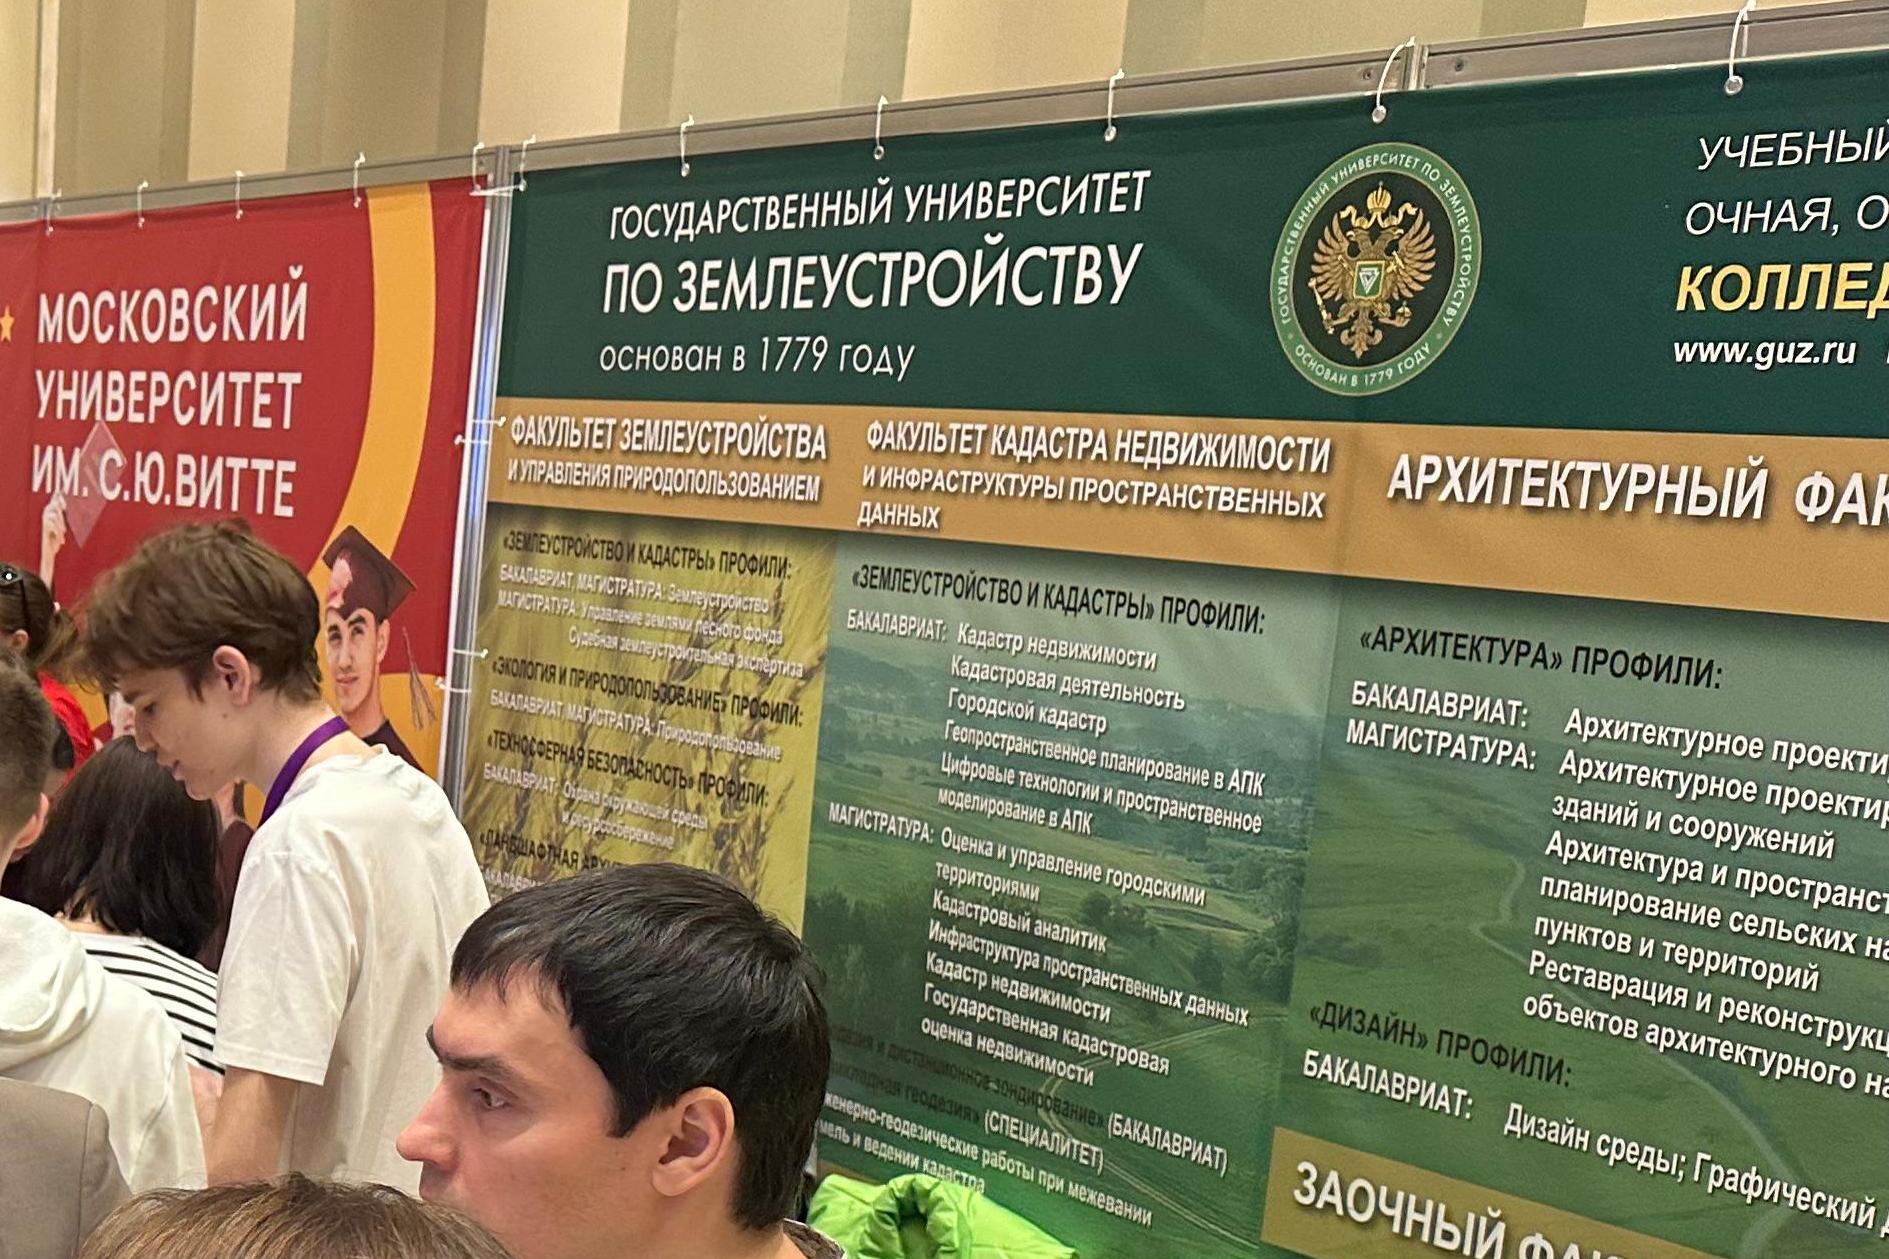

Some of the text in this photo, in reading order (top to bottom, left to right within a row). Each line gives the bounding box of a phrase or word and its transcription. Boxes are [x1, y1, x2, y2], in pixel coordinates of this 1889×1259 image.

[609, 169, 1151, 243] ГОСУДАРСТВЕННЫЙ УНИВЕРСИТЕТ
[1685, 198, 1839, 240] ОЧНАЯ,
[602, 232, 1144, 314] ПО ЗЕМЛЕУСТРОЙСТВУ
[1276, 152, 1473, 328] ГОСУДАРСТВЕННЫЙ УНИВЕРСИТЕТ ЗЕМЛЕУСТРОЙСТВУ
[38, 265, 308, 344] МОСКОВСКИЙ
[600, 336, 915, 381] основан в 1779 году
[1293, 343, 1348, 387] ОСНОВАН
[1674, 338, 1856, 368] www.guz.ru
[35, 370, 302, 431] УНИВЕРСИТЕТ
[510, 414, 827, 461] ФАКУЛЬТЕТ ЗЕМЛЕУСТРОЙСТВА
[867, 419, 1332, 475] ФАКУЛЬТЕТ КАДАСТРА НЕДВИЖИМОСТИ
[31, 444, 297, 519] ИМ. С.Ю.ВИТТЕ
[507, 458, 820, 502] И УПРАВЛЕНИЯ ПРИРОДОПОЛЬЗОВАНИЕМ
[862, 464, 1326, 519] И ИНФРАСТРУКТУРЫ ПРОСТРАНСТВЕННЫХ
[1387, 453, 1768, 520] АРХИТЕКТУРНЫЙ
[857, 501, 940, 530] ДАННЫХ
[503, 530, 792, 580] «ЗЕМЛЕУСТРОЙСТВО КАДАСТРЫ» ПРОФИЛИ:
[668, 584, 769, 614] Землеустройство
[852, 564, 1265, 635] «ЗЕМЛЕУСТРОЙСТВО И КАДАСТРЫ» ПРОФИЛИ:
[846, 608, 1158, 671] БАКАЛАВРИАТ: Кадастр недвижимости
[1360, 624, 1723, 690] «АРХИТЕКТУРА» ПРОФИЛИ:
[492, 655, 804, 727] «ЭКОЛОГИЯ ПРИРОДОПОЛЬЗОВАНИЕ» ПРОФИЛИ:
[948, 687, 1107, 737] Городской кадастр
[951, 655, 1186, 712] Кадастровая деятельность
[1352, 680, 1764, 759] БАКАЛАВРИАТ: Архитектурное
[486, 728, 769, 806] «ТЕХНОСФЕРНАЯ БЕЗОПАСНОСТЬ» ПРОФИЛИ:
[944, 719, 1266, 798] Геопространственное планирование АПК
[1346, 719, 1757, 802] МАГИСТРАТУРА: Архитектурное
[938, 789, 1094, 836] моделирование АПК
[941, 752, 1263, 836] Цифровые технологии пространственное
[828, 803, 1207, 907] МАГИСТРАТУРА: Оценка управление городскими
[1545, 830, 1727, 885] Архитектура и
[1551, 796, 1836, 860] зданий и сооружений
[936, 861, 1040, 902] территориями
[1540, 875, 1856, 954] планирование сельских
[933, 889, 1108, 954] Кадастровый аналитик
[1534, 916, 1821, 992] пунктов и территорий
[926, 952, 1111, 1024] Кадастр недвижимости
[929, 921, 1249, 1027] Инфраструктура пространственных данных
[1529, 950, 1711, 1012] Реставрация и
[921, 1020, 973, 1050] оценка
[976, 1036, 1095, 1086] недвижимости
[924, 983, 1170, 1076] Государственная кадастровая
[1311, 1000, 1572, 1088] «ДИЗАЙН» ПРОФИЛИ:
[1523, 994, 1856, 1091] объектов архитектурного
[864, 1137, 919, 1170] ведении
[984, 1107, 1104, 1176] (СПЕЦИАЛИТЕТ)
[1108, 1112, 1227, 1178] (БАКАЛАВРИАТ)
[1303, 1050, 1473, 1121] БАКАЛАВРИАТ:
[1504, 1103, 1589, 1153] Дизайн
[1596, 1134, 1686, 1184] среды;
[1692, 1152, 1876, 1229] Графический
[981, 1143, 1153, 1227] работы при межевании
